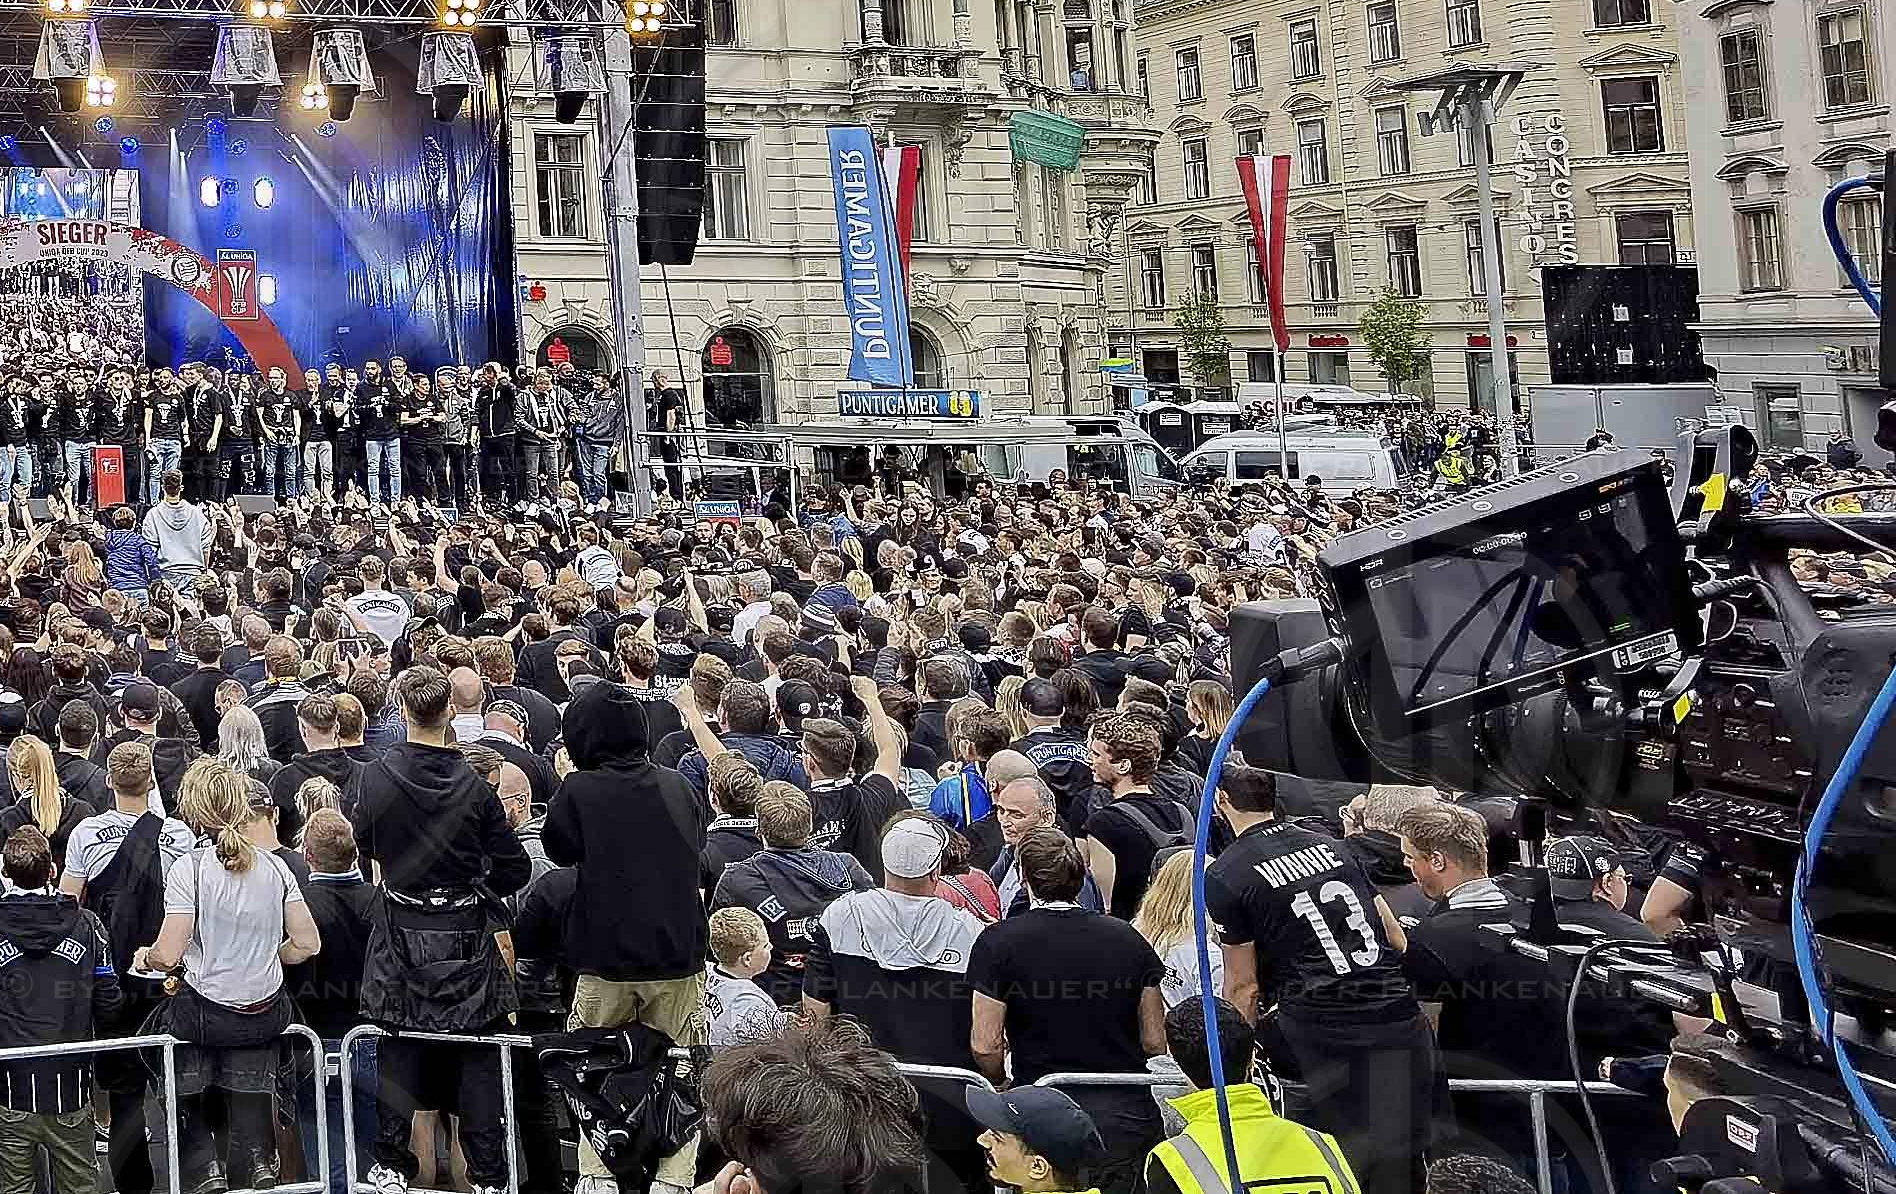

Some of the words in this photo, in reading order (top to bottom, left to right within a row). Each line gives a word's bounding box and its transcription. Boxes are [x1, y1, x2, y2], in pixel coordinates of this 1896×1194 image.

[1510, 116, 1546, 255] CASINO
[37, 222, 109, 245] SIEGER
[842, 393, 940, 416] PUNTIGAMER
[1253, 843, 1343, 890] WINNIE
[1290, 880, 1381, 976] 13
